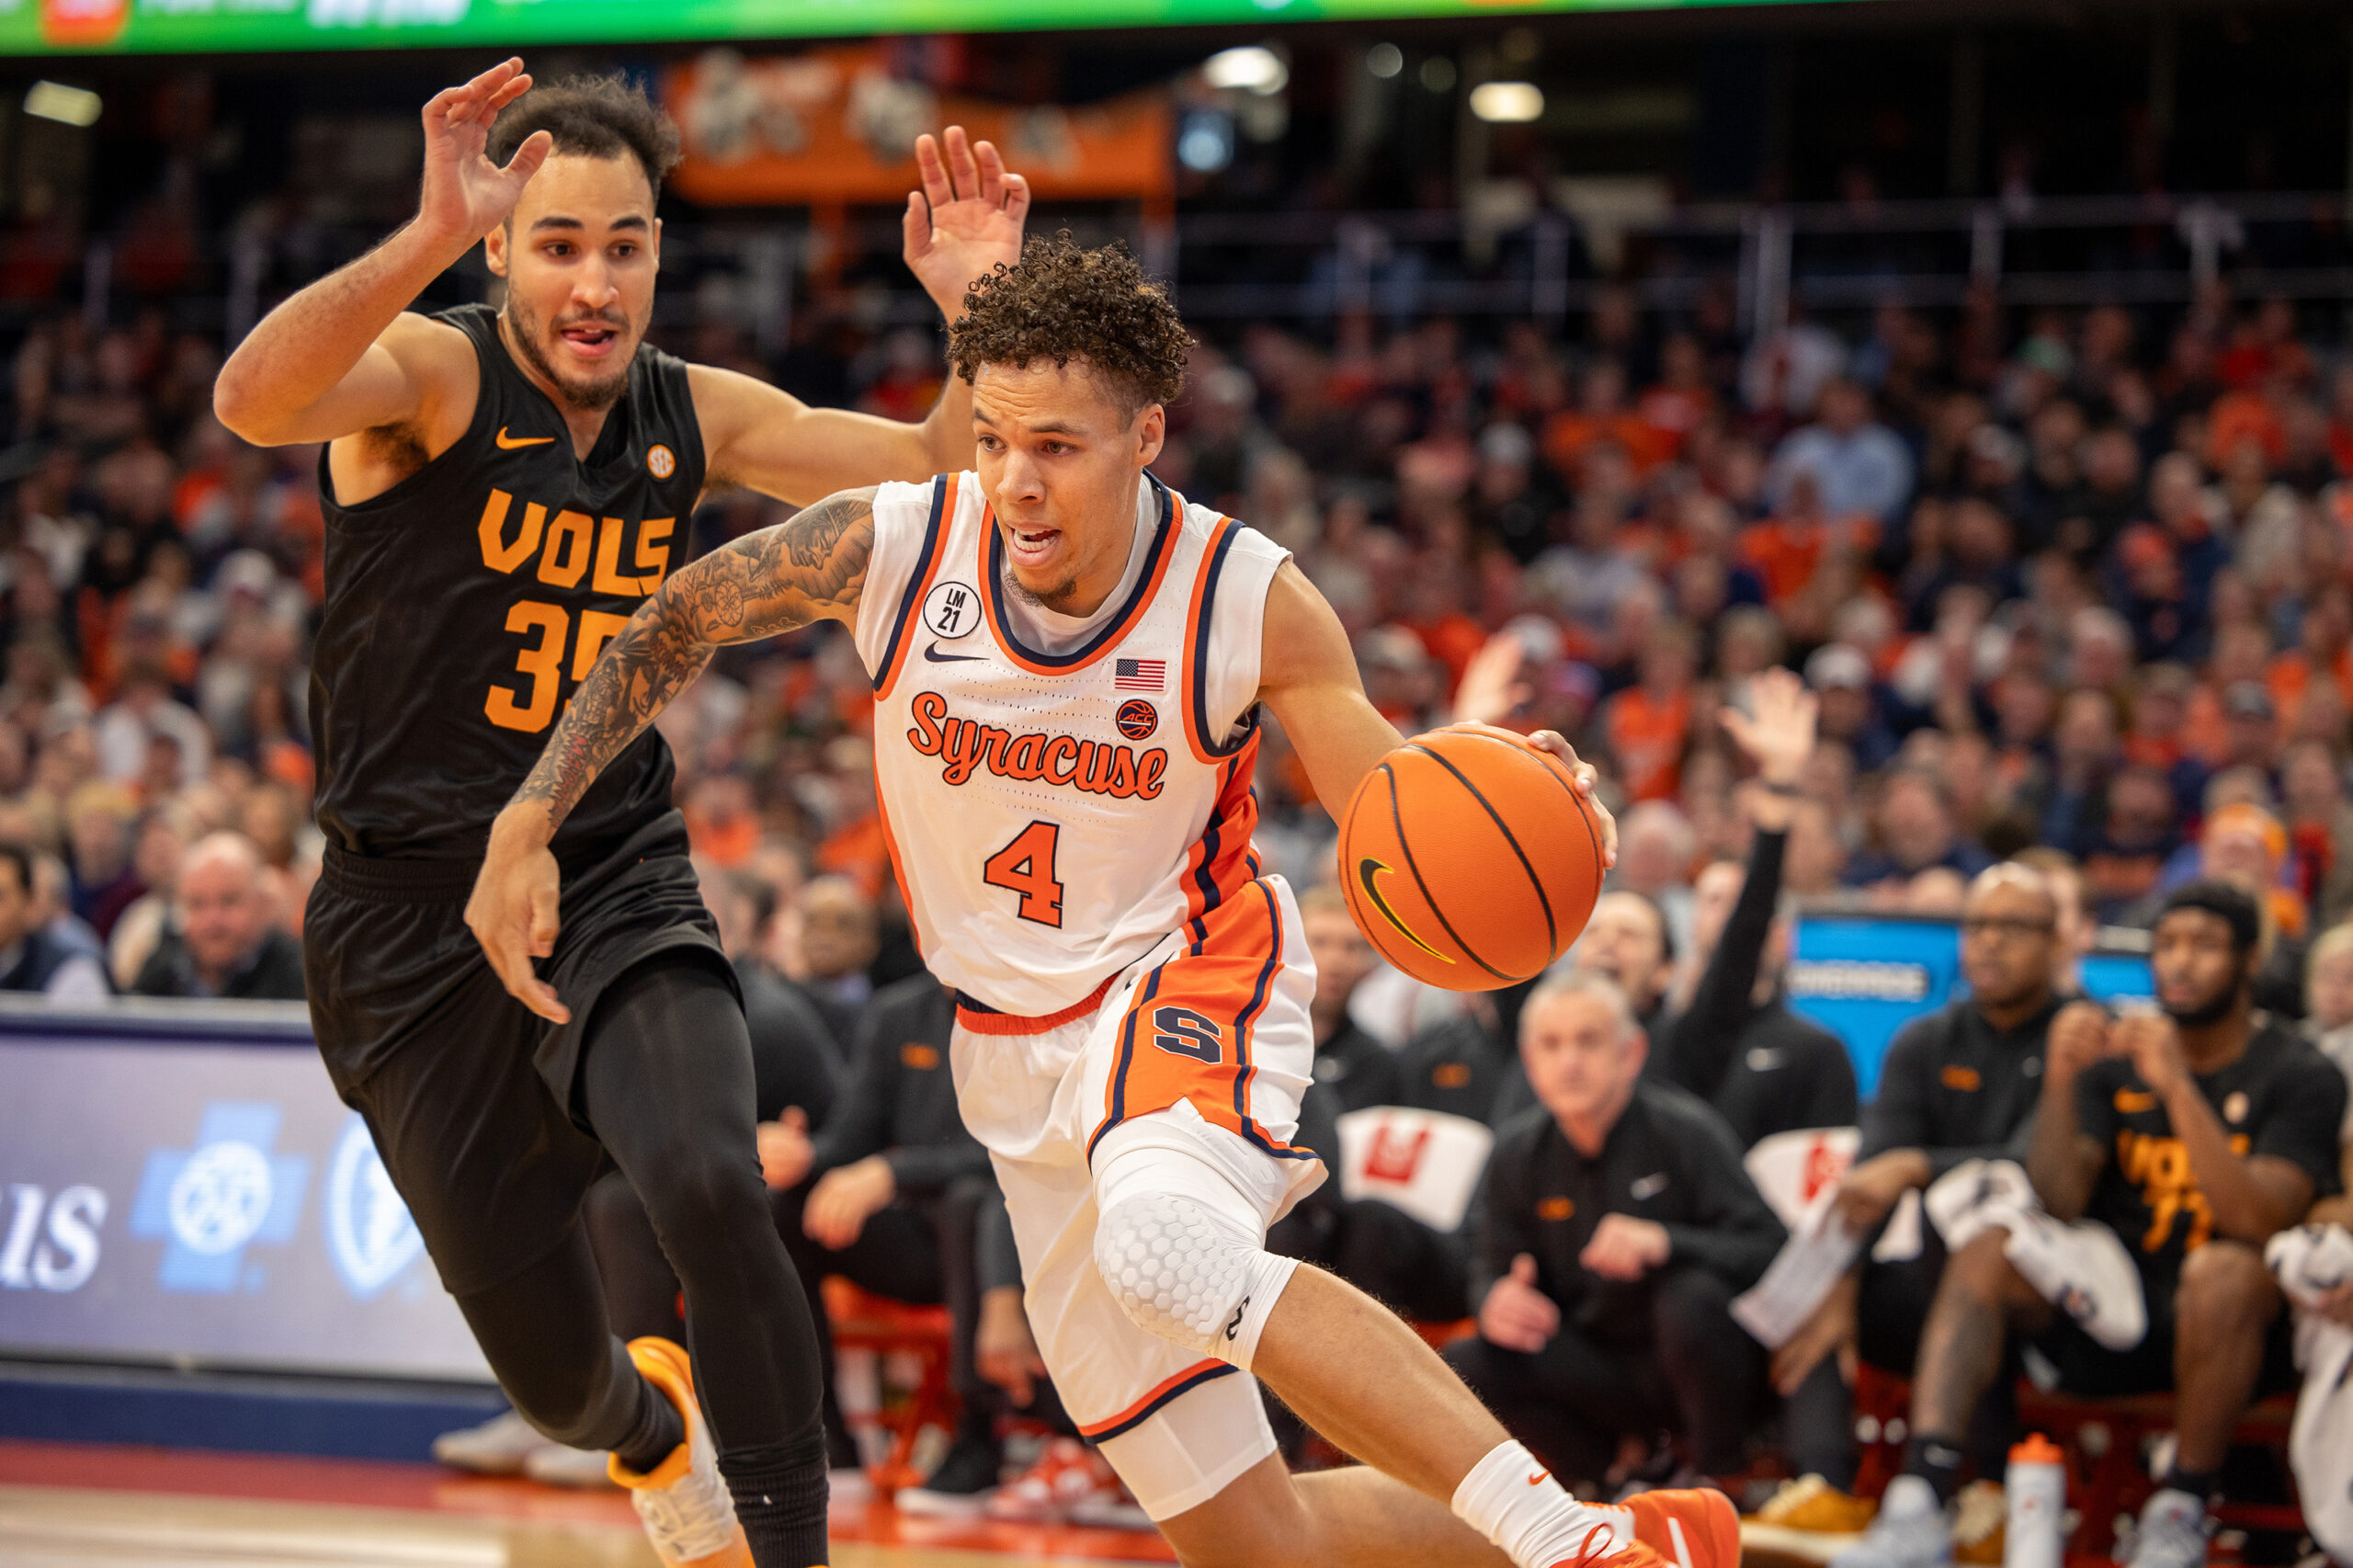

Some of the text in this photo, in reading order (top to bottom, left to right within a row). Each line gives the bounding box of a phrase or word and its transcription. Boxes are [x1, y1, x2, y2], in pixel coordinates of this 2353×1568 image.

[478, 488, 676, 597] VOLS
[938, 606, 961, 632] 21
[946, 588, 966, 608] LM
[907, 691, 1168, 800] Syracuse
[983, 820, 1064, 929] 4
[1154, 1006, 1222, 1064] S
